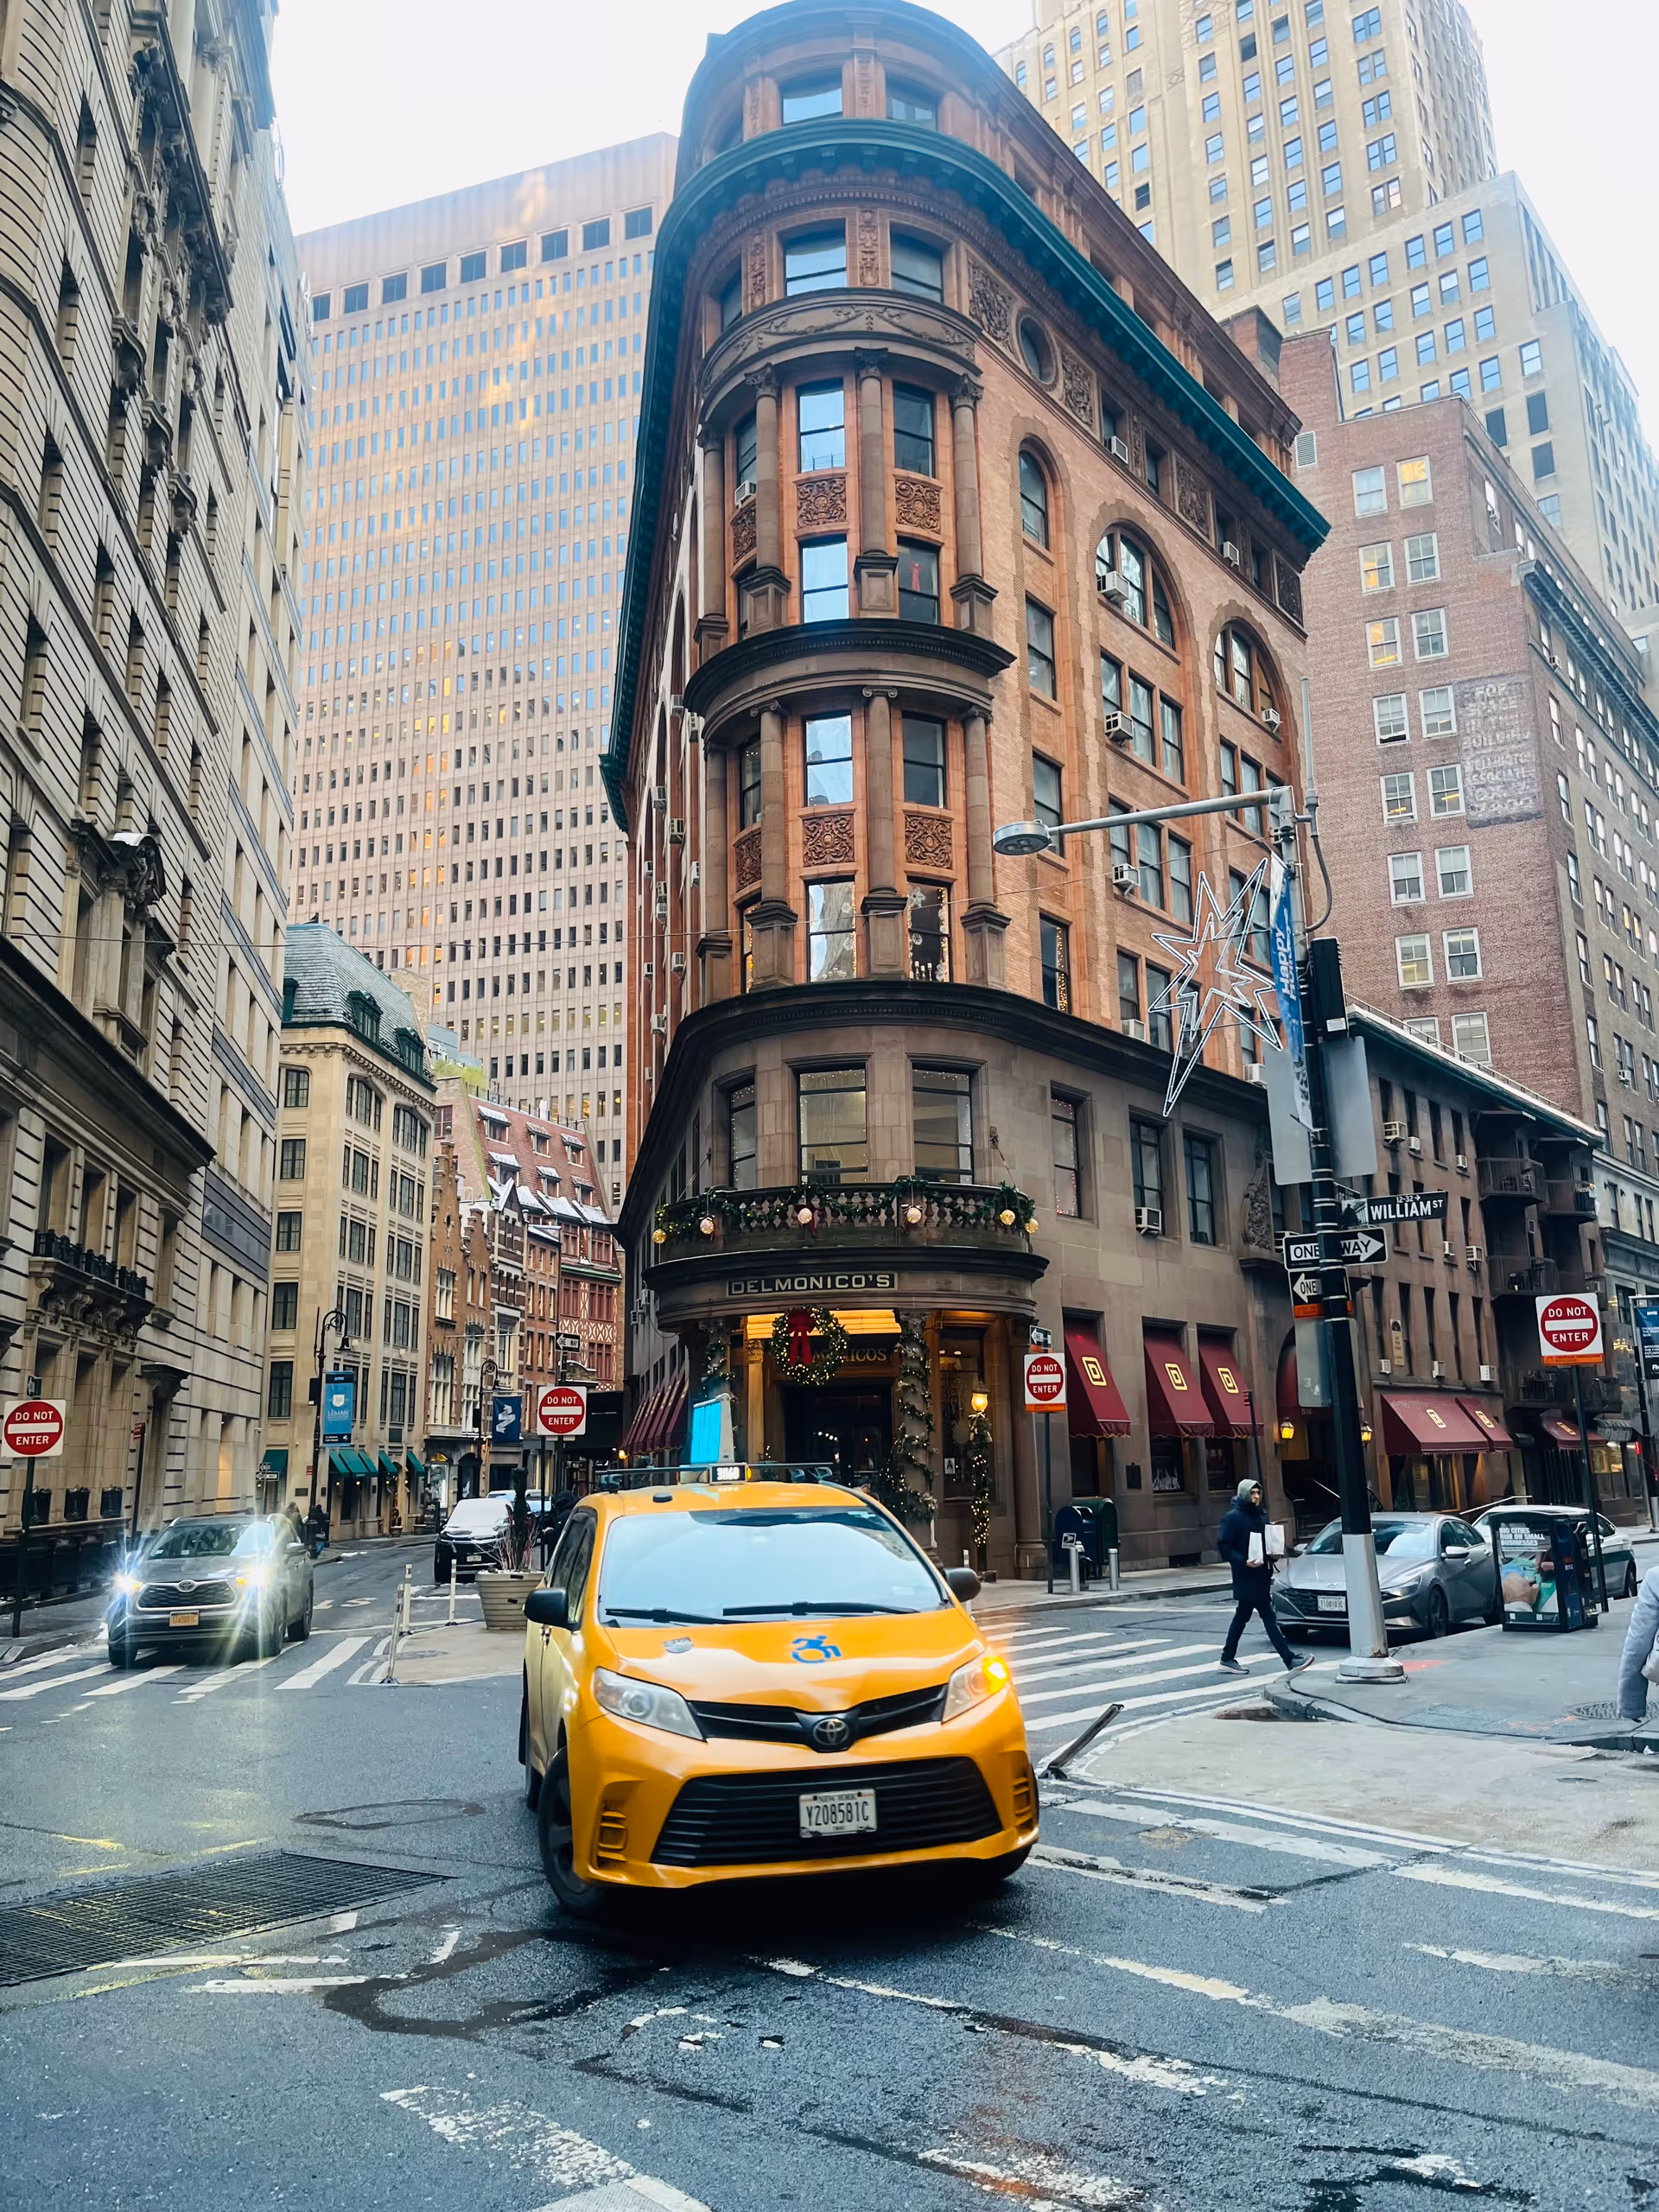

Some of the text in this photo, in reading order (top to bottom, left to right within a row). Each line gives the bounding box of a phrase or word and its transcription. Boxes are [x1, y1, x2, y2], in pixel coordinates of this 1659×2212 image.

[1275, 925, 1290, 994] Happy
[1370, 1199, 1443, 1220] WILLIAM ST
[1294, 1240, 1371, 1259] ONE WAY
[731, 1274, 890, 1294] DELMONICO'S
[1300, 1281, 1317, 1294] ONE
[1548, 1306, 1587, 1318] DO NOT
[1552, 1332, 1589, 1343] ENTER
[1033, 1385, 1058, 1394] ENTER
[15, 1410, 54, 1421] DO NOT
[548, 1417, 575, 1426] ENTER
[16, 1435, 49, 1446] ENTER
[806, 1801, 869, 1827] Y208581C
